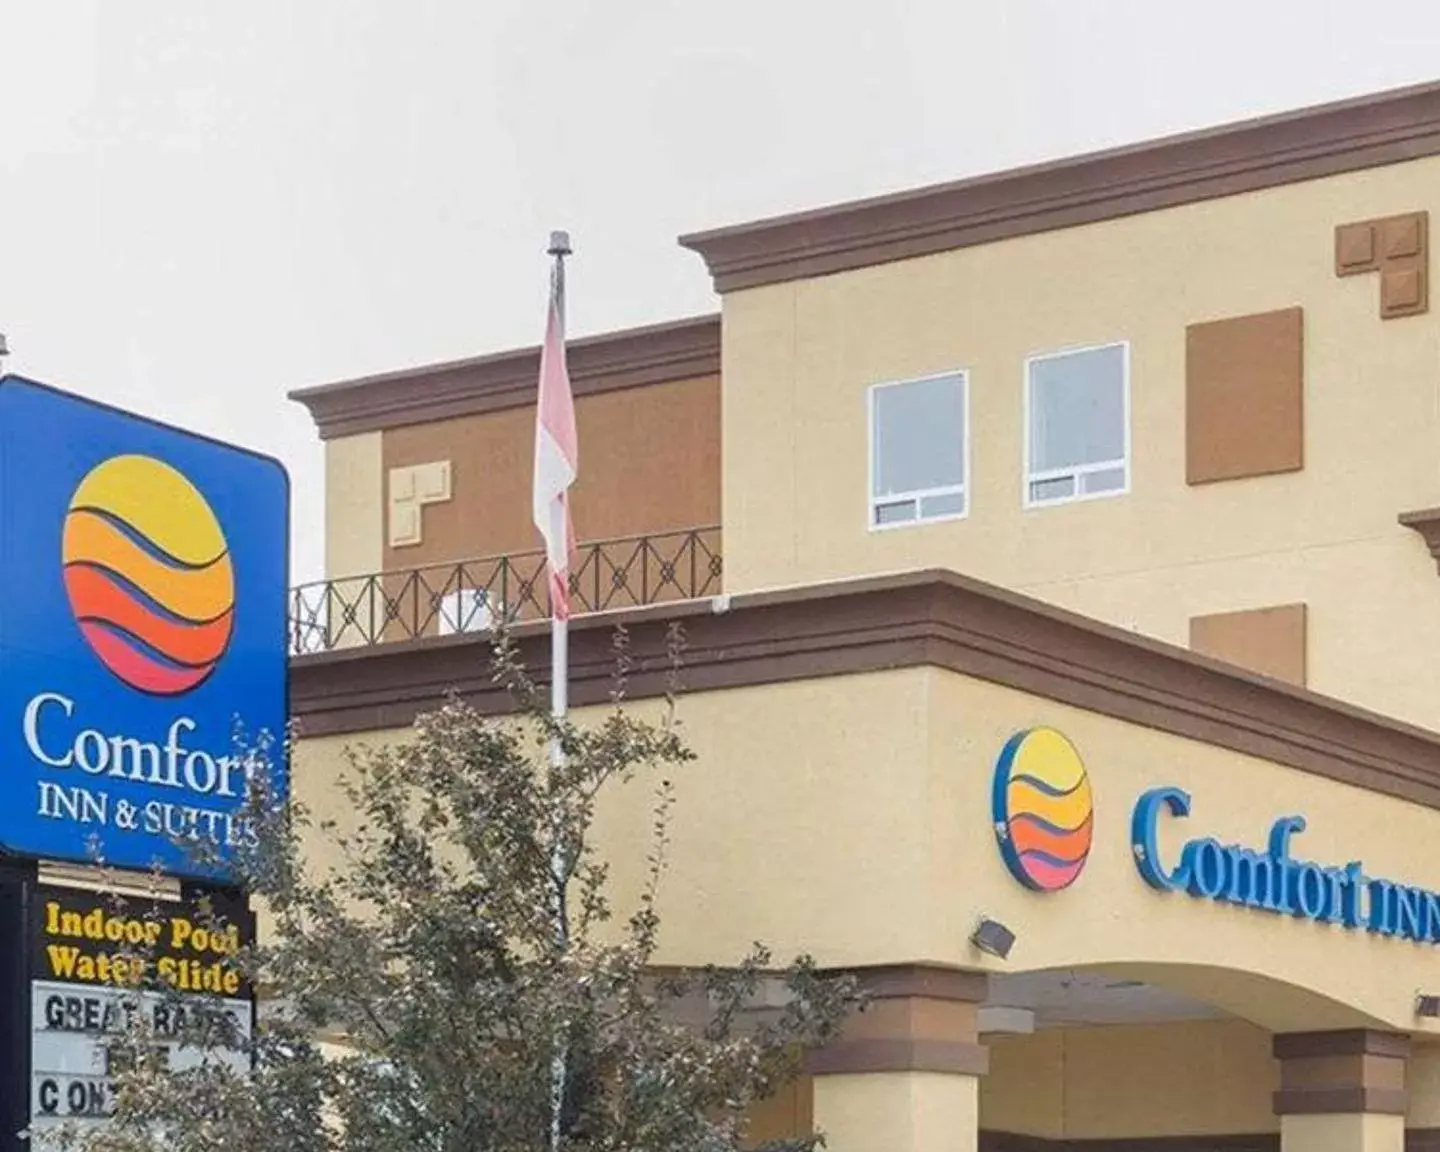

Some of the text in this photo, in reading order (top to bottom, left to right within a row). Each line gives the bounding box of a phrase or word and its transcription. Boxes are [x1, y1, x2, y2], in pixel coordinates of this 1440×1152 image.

[22, 692, 262, 798] Comfort
[37, 780, 260, 848] INN & SUITES
[1131, 787, 1371, 930] Comfort
[46, 901, 161, 946] Indoor
[157, 956, 239, 994] Slide
